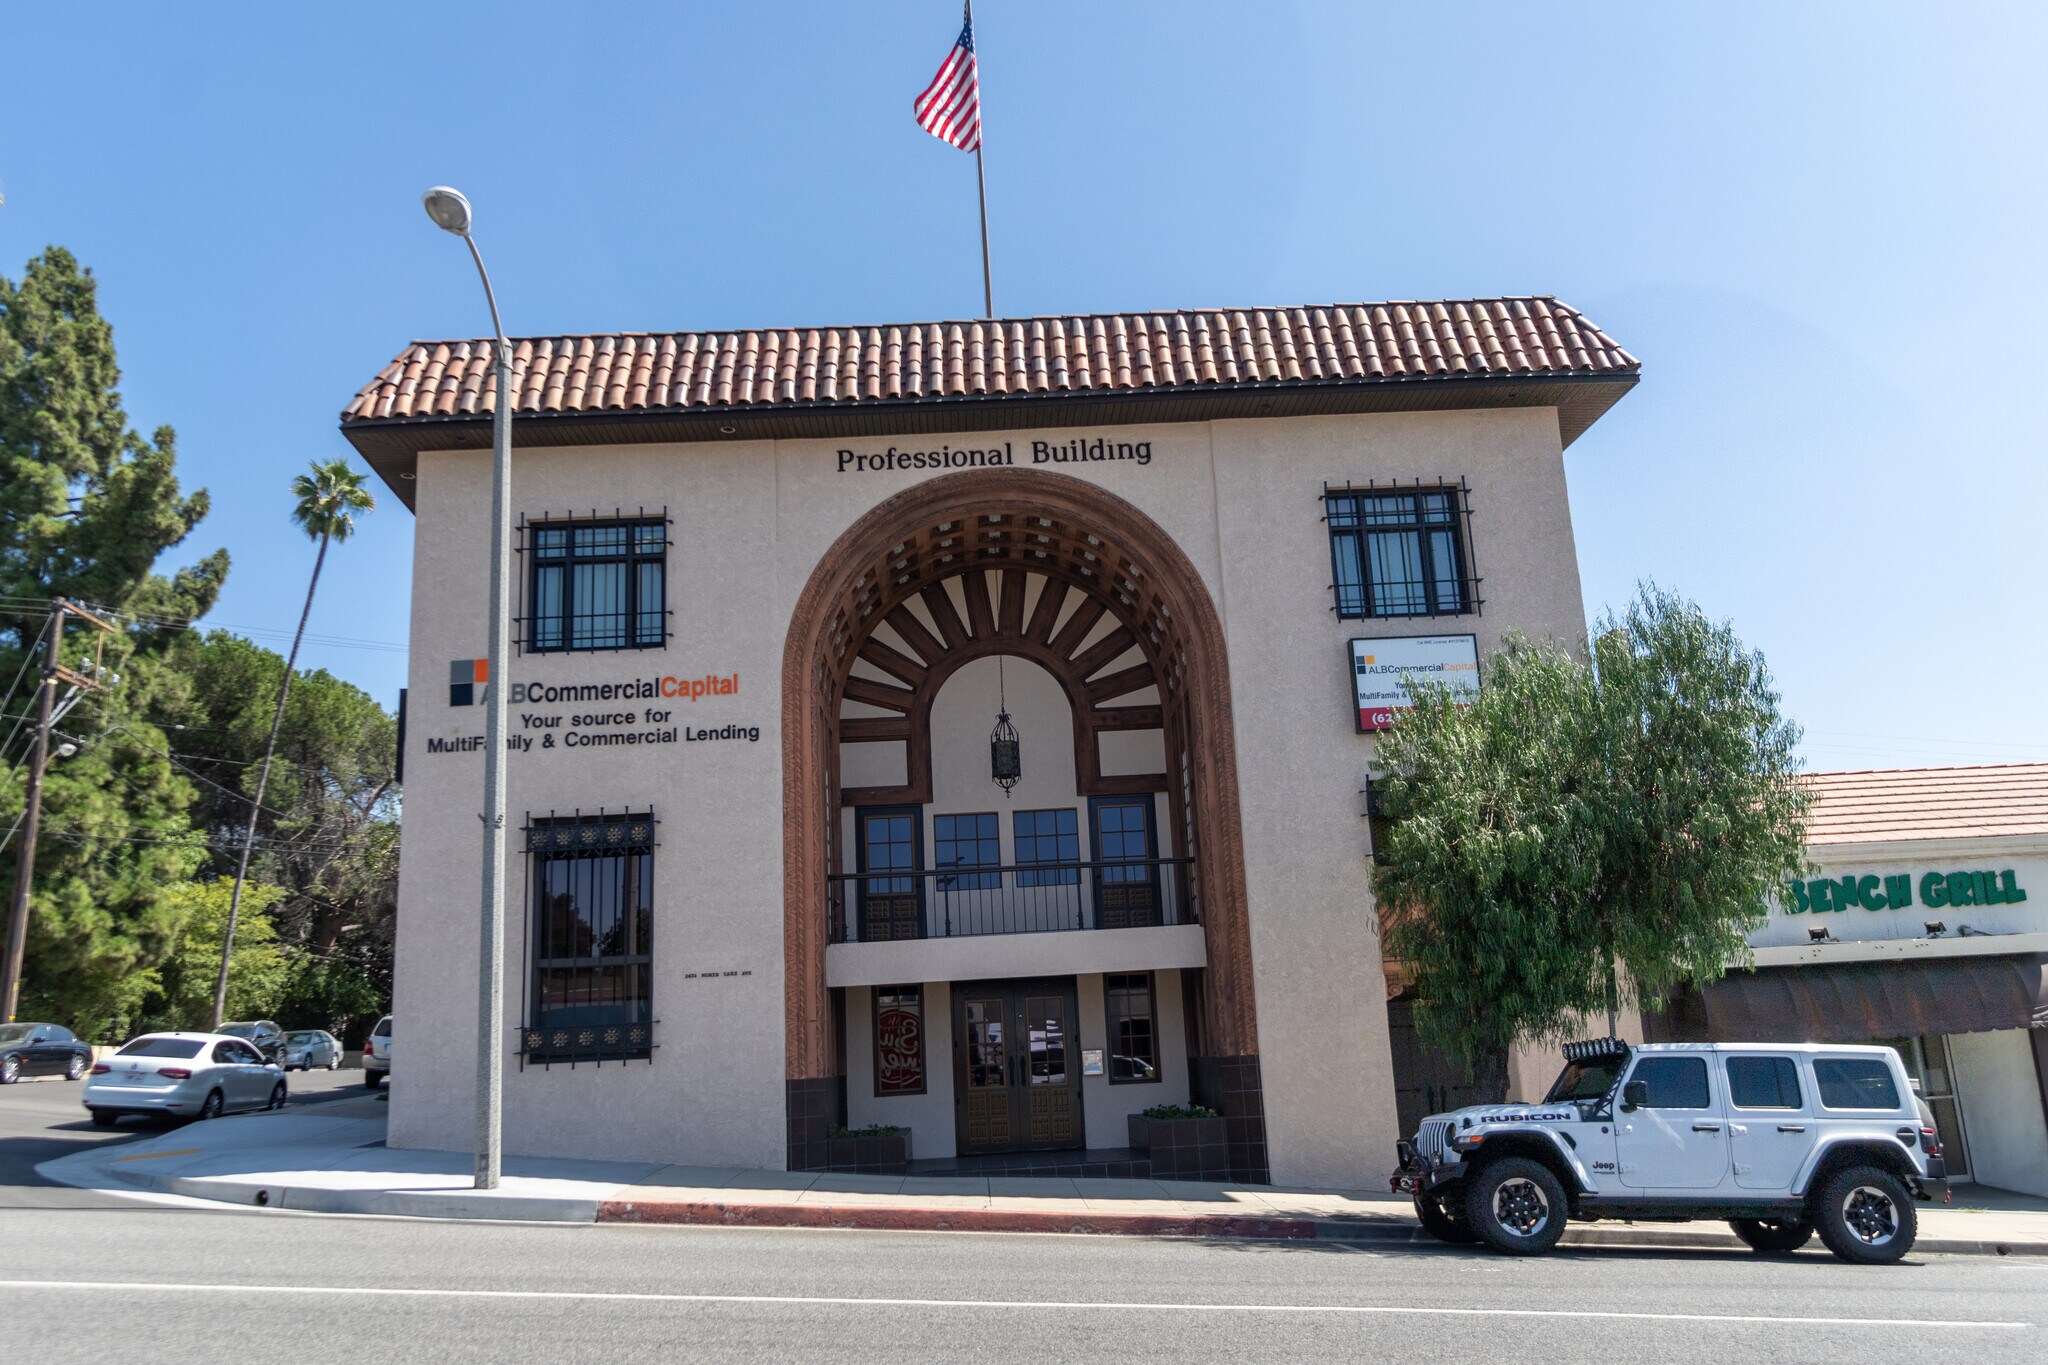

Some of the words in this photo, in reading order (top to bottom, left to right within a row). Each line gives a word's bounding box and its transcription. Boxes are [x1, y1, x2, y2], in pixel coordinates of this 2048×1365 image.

[836, 443, 1014, 473] Professional
[1031, 438, 1153, 466] Building
[1359, 691, 1400, 701] MultiFamily
[1401, 690, 1408, 699] &
[521, 713, 563, 729] Your
[571, 711, 636, 728] source
[646, 708, 672, 724] for
[427, 734, 534, 753] MultiFily
[542, 732, 556, 749] &
[564, 728, 678, 748] Commercial
[685, 724, 760, 742] Lending
[1784, 874, 1913, 915] BENCH
[1920, 869, 2028, 909] GRILL
[1480, 1113, 1571, 1123] RUBICON
[1592, 1161, 1615, 1170] Jeep
